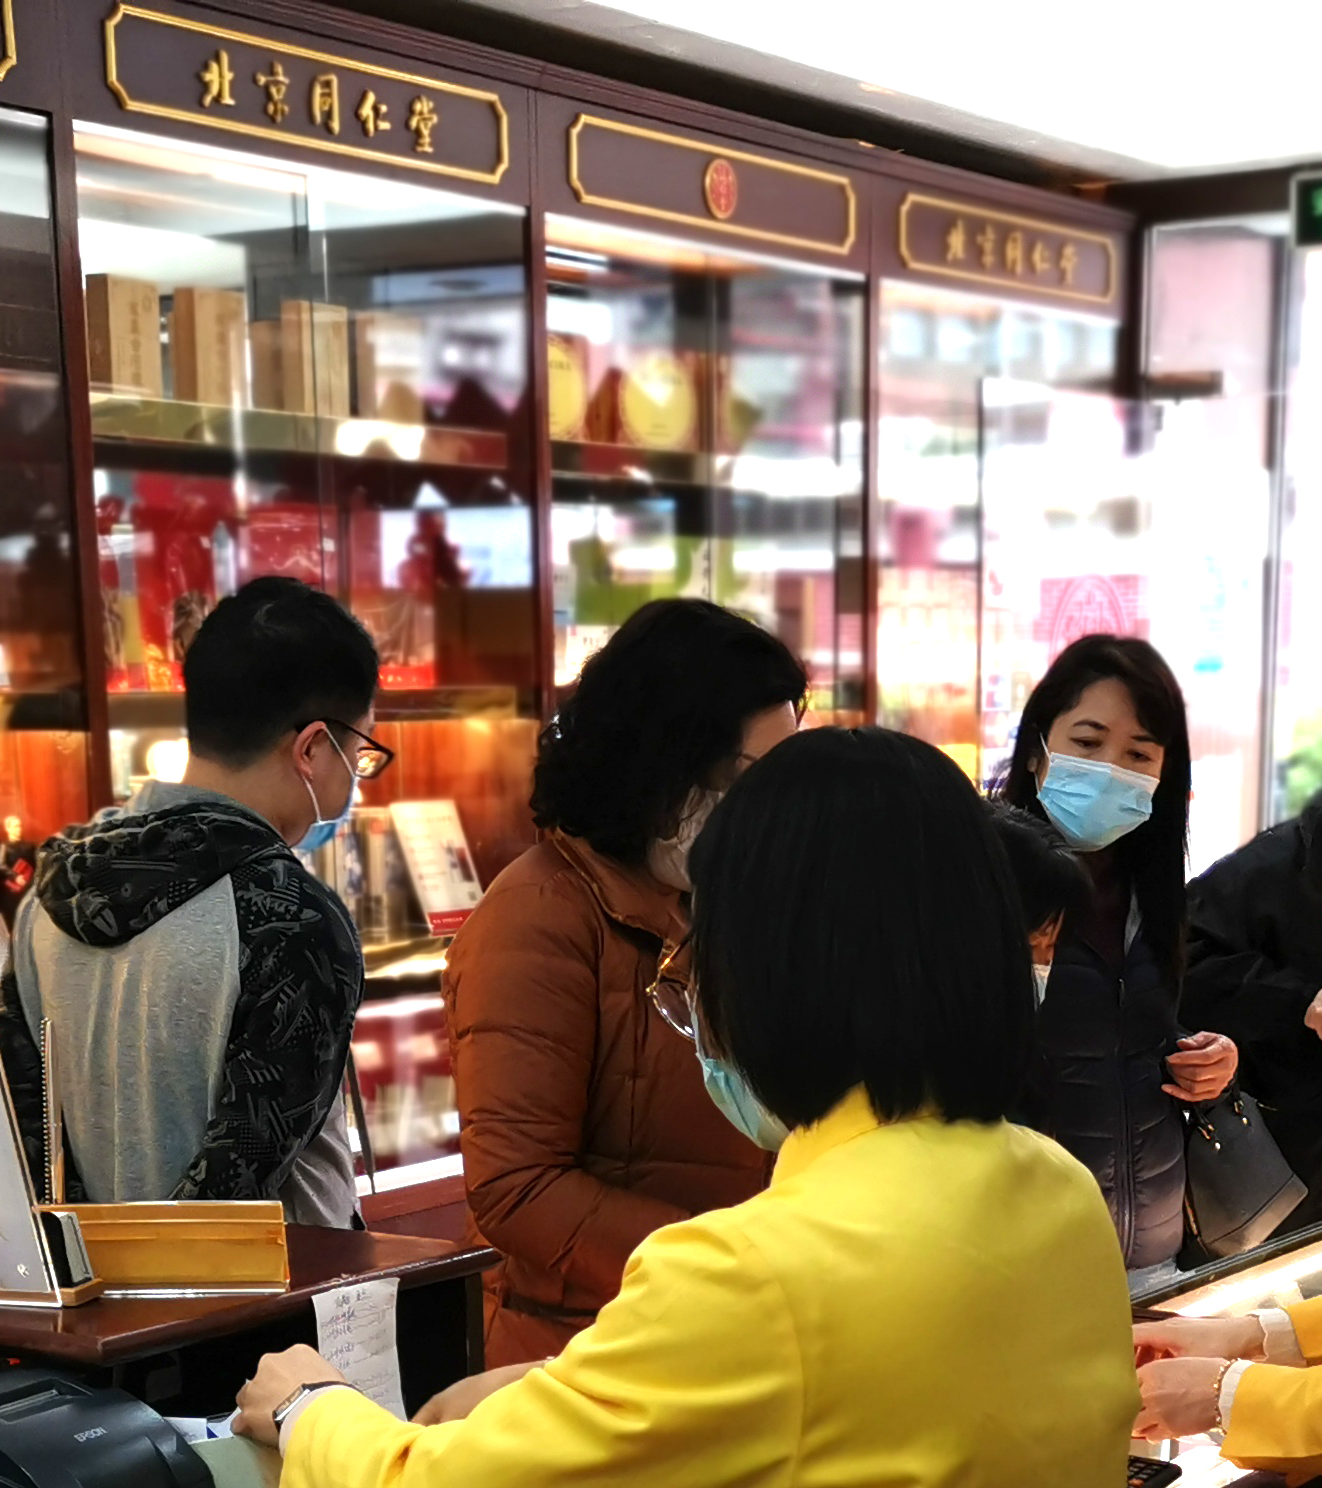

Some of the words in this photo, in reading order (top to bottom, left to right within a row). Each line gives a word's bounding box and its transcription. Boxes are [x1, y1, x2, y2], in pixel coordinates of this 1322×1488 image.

[200, 49, 438, 153] 北京同仁堂
[946, 219, 1078, 285] 北京同仁堂
[73, 1426, 108, 1442] EPSON
